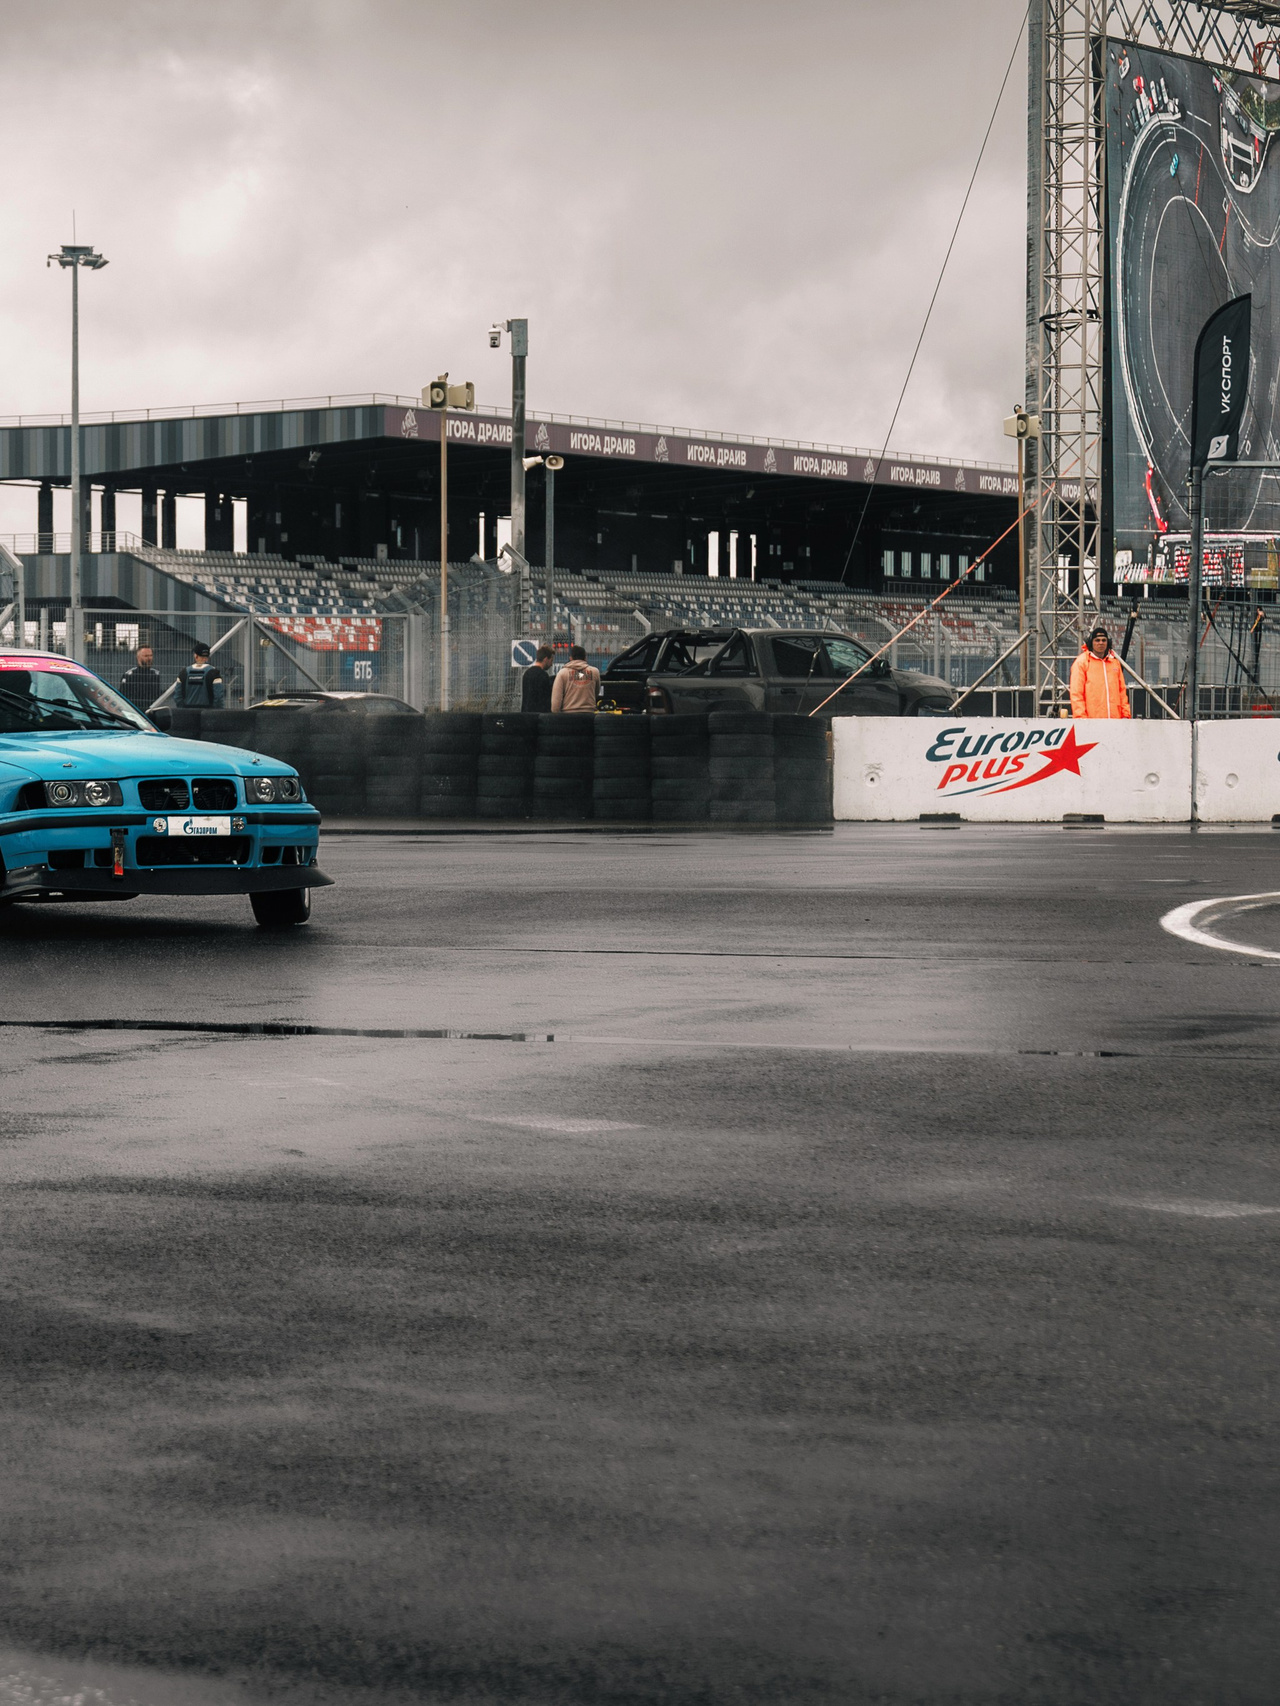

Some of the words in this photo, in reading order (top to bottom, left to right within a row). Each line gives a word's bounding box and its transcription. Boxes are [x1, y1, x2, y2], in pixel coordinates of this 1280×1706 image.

[1221, 335, 1232, 391] СПОРТ
[1221, 393, 1231, 414] VK
[570, 432, 602, 451] ИГОРА
[687, 444, 716, 463] ИГОРА
[793, 455, 820, 474] ИГОРА
[890, 466, 915, 483] ИГОРА
[979, 474, 1002, 491] ИГОРА
[354, 660, 373, 679] ВТБ
[193, 826, 218, 835] ГАЗПРОМ
